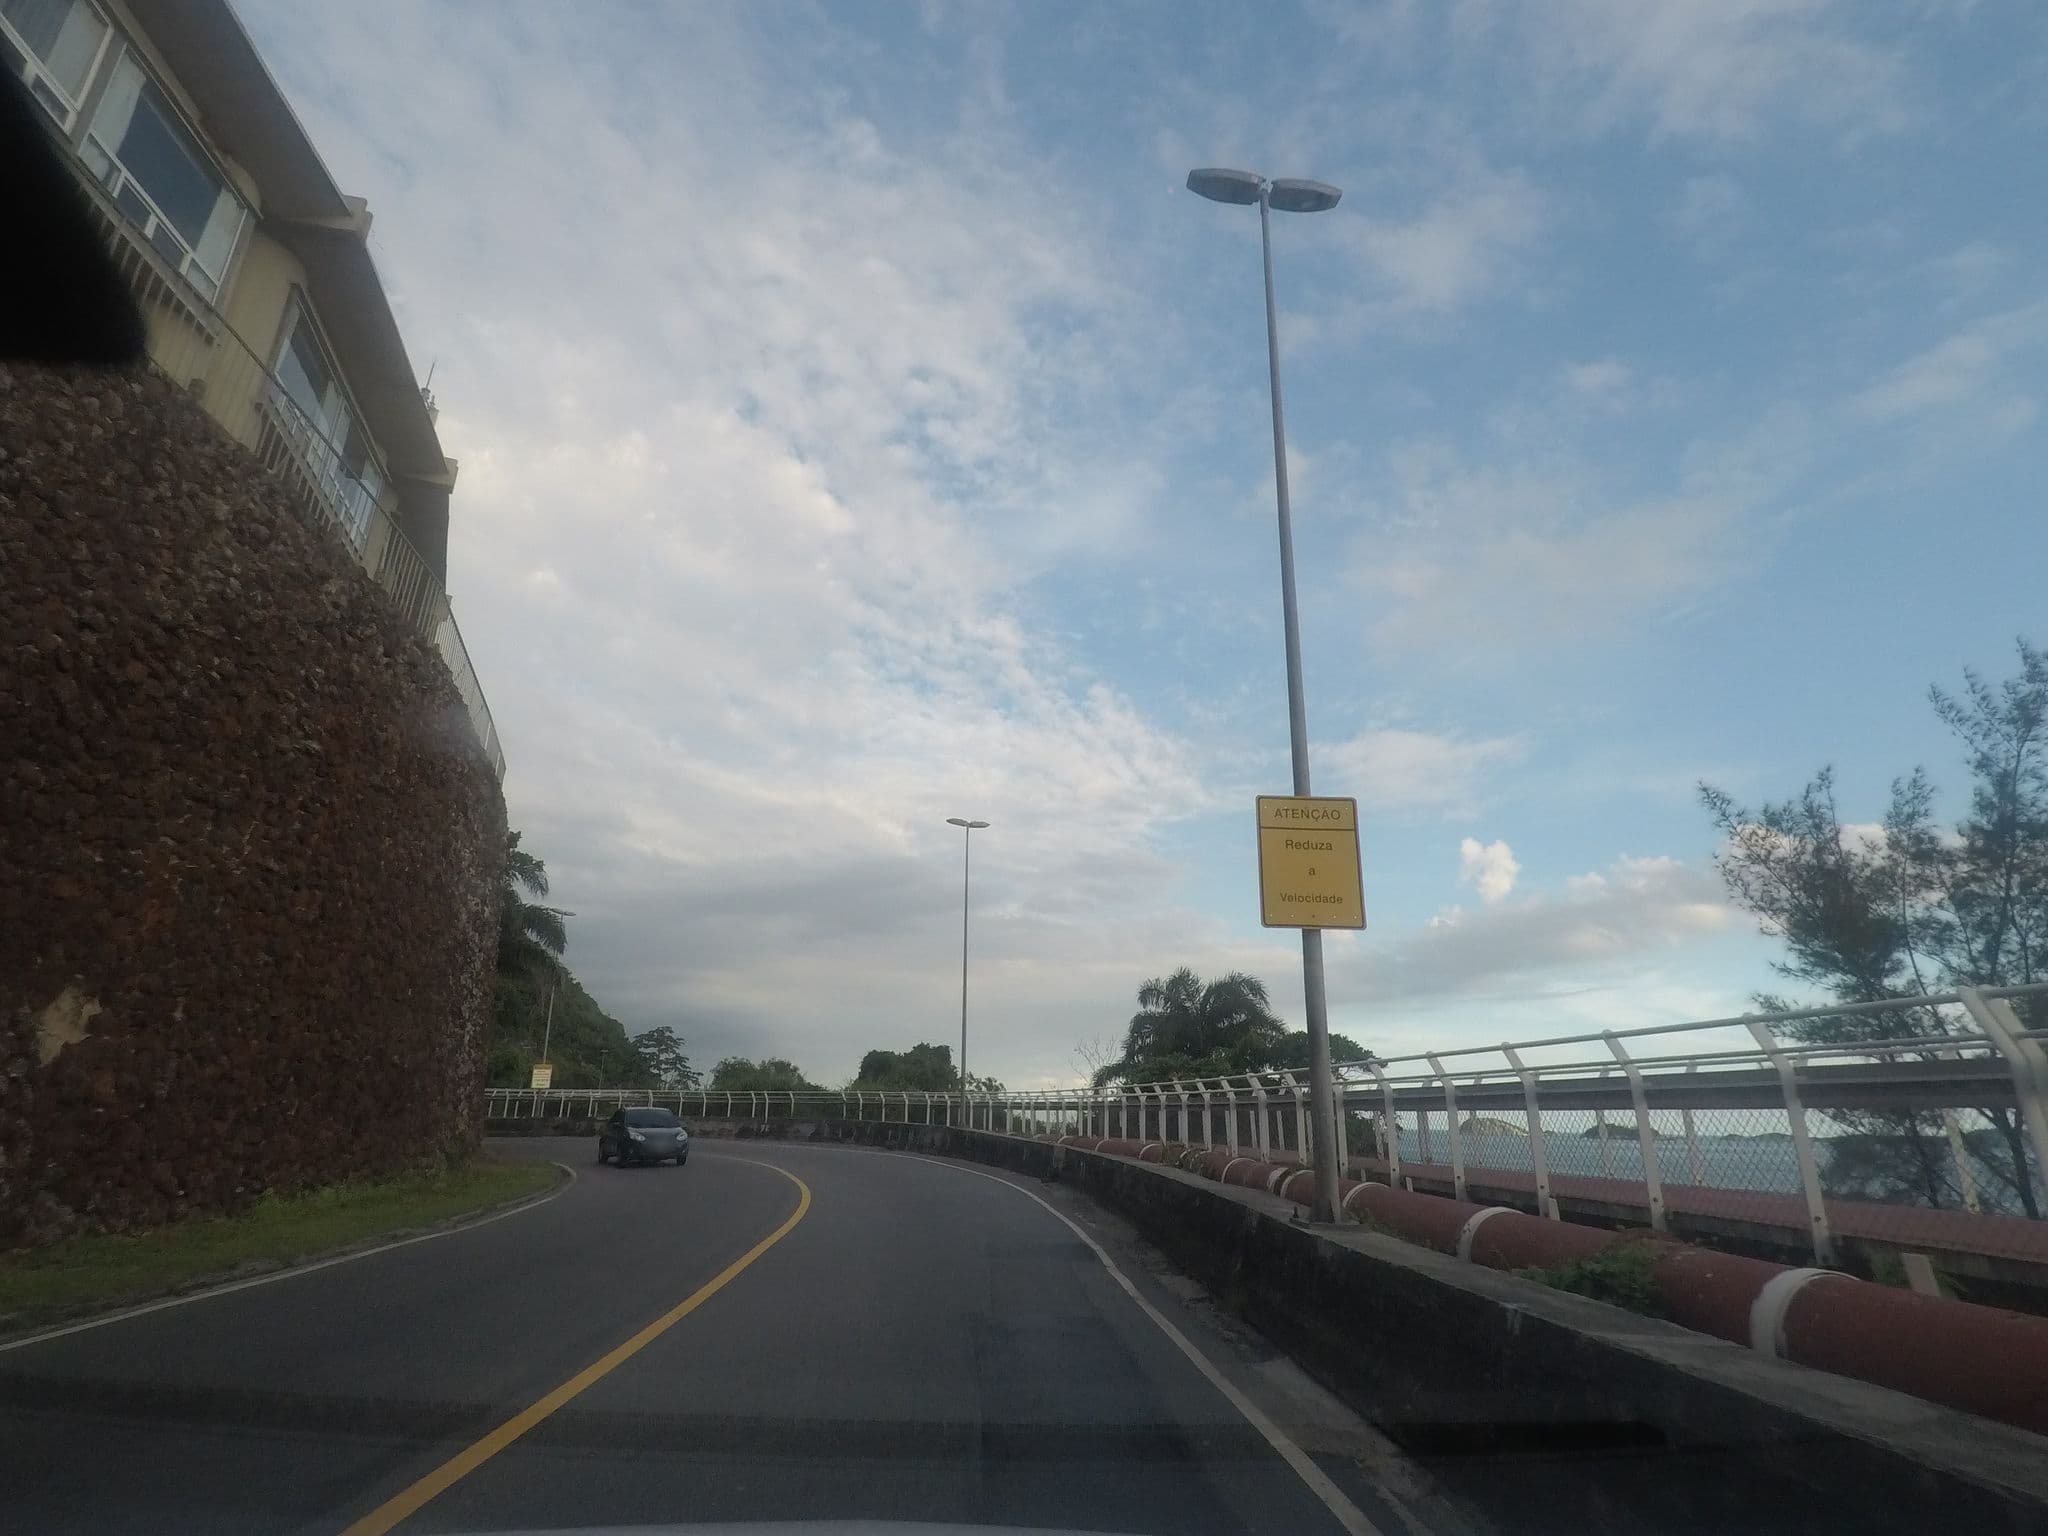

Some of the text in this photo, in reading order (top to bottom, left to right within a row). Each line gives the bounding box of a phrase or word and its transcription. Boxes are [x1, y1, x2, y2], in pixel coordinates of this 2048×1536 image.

[1285, 839, 1333, 851] Reduza
[1308, 867, 1316, 876] a
[1280, 892, 1343, 904] Velocidade
